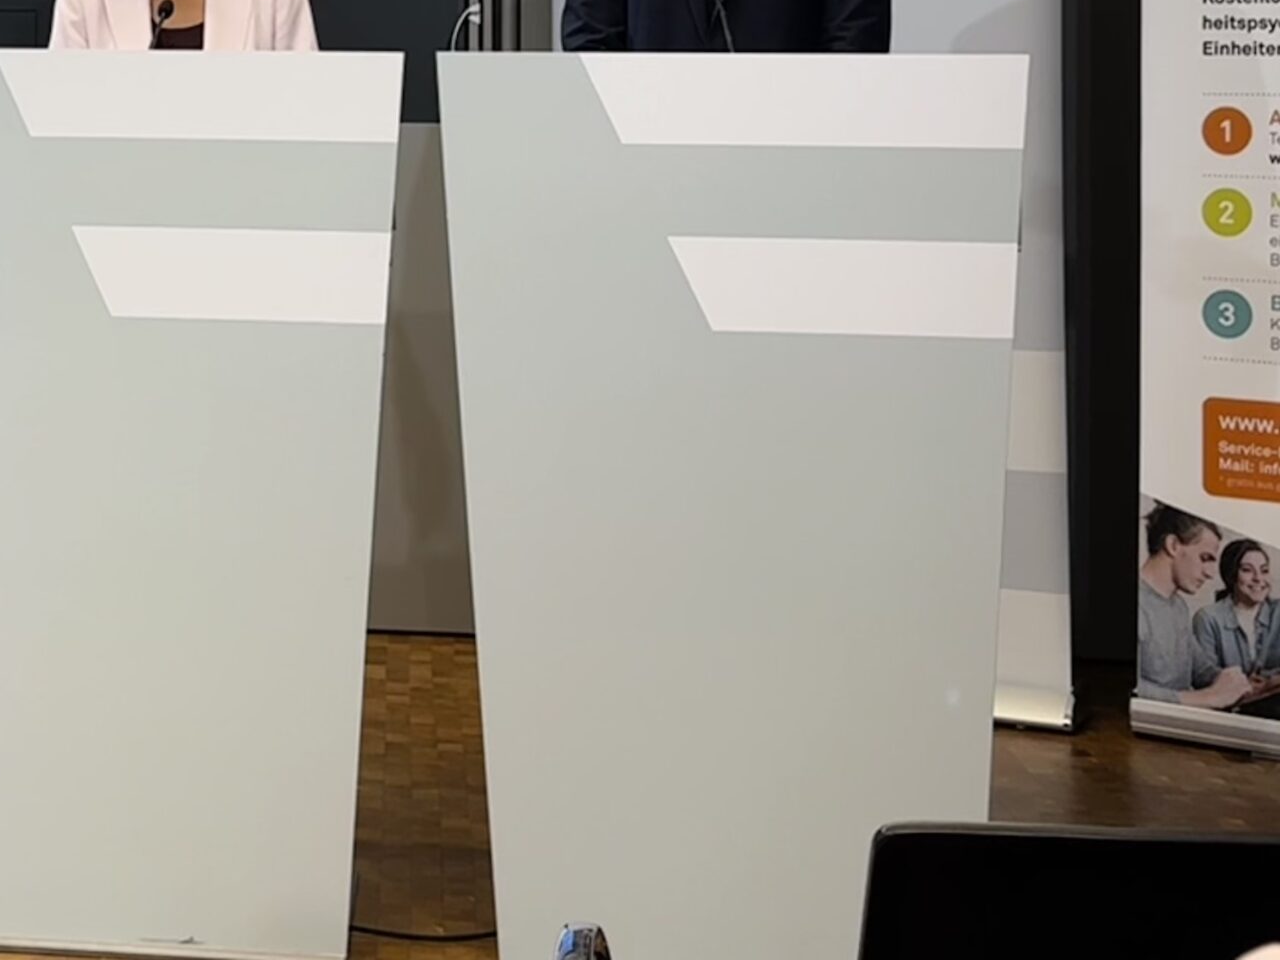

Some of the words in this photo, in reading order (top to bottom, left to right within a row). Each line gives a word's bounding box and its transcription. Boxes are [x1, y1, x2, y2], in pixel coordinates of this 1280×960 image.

[1202, 14, 1280, 34] heitspsy
[1220, 119, 1232, 143] 1
[1219, 200, 1235, 224] 2
[1217, 302, 1236, 326] 3
[1218, 439, 1280, 458] Service-
